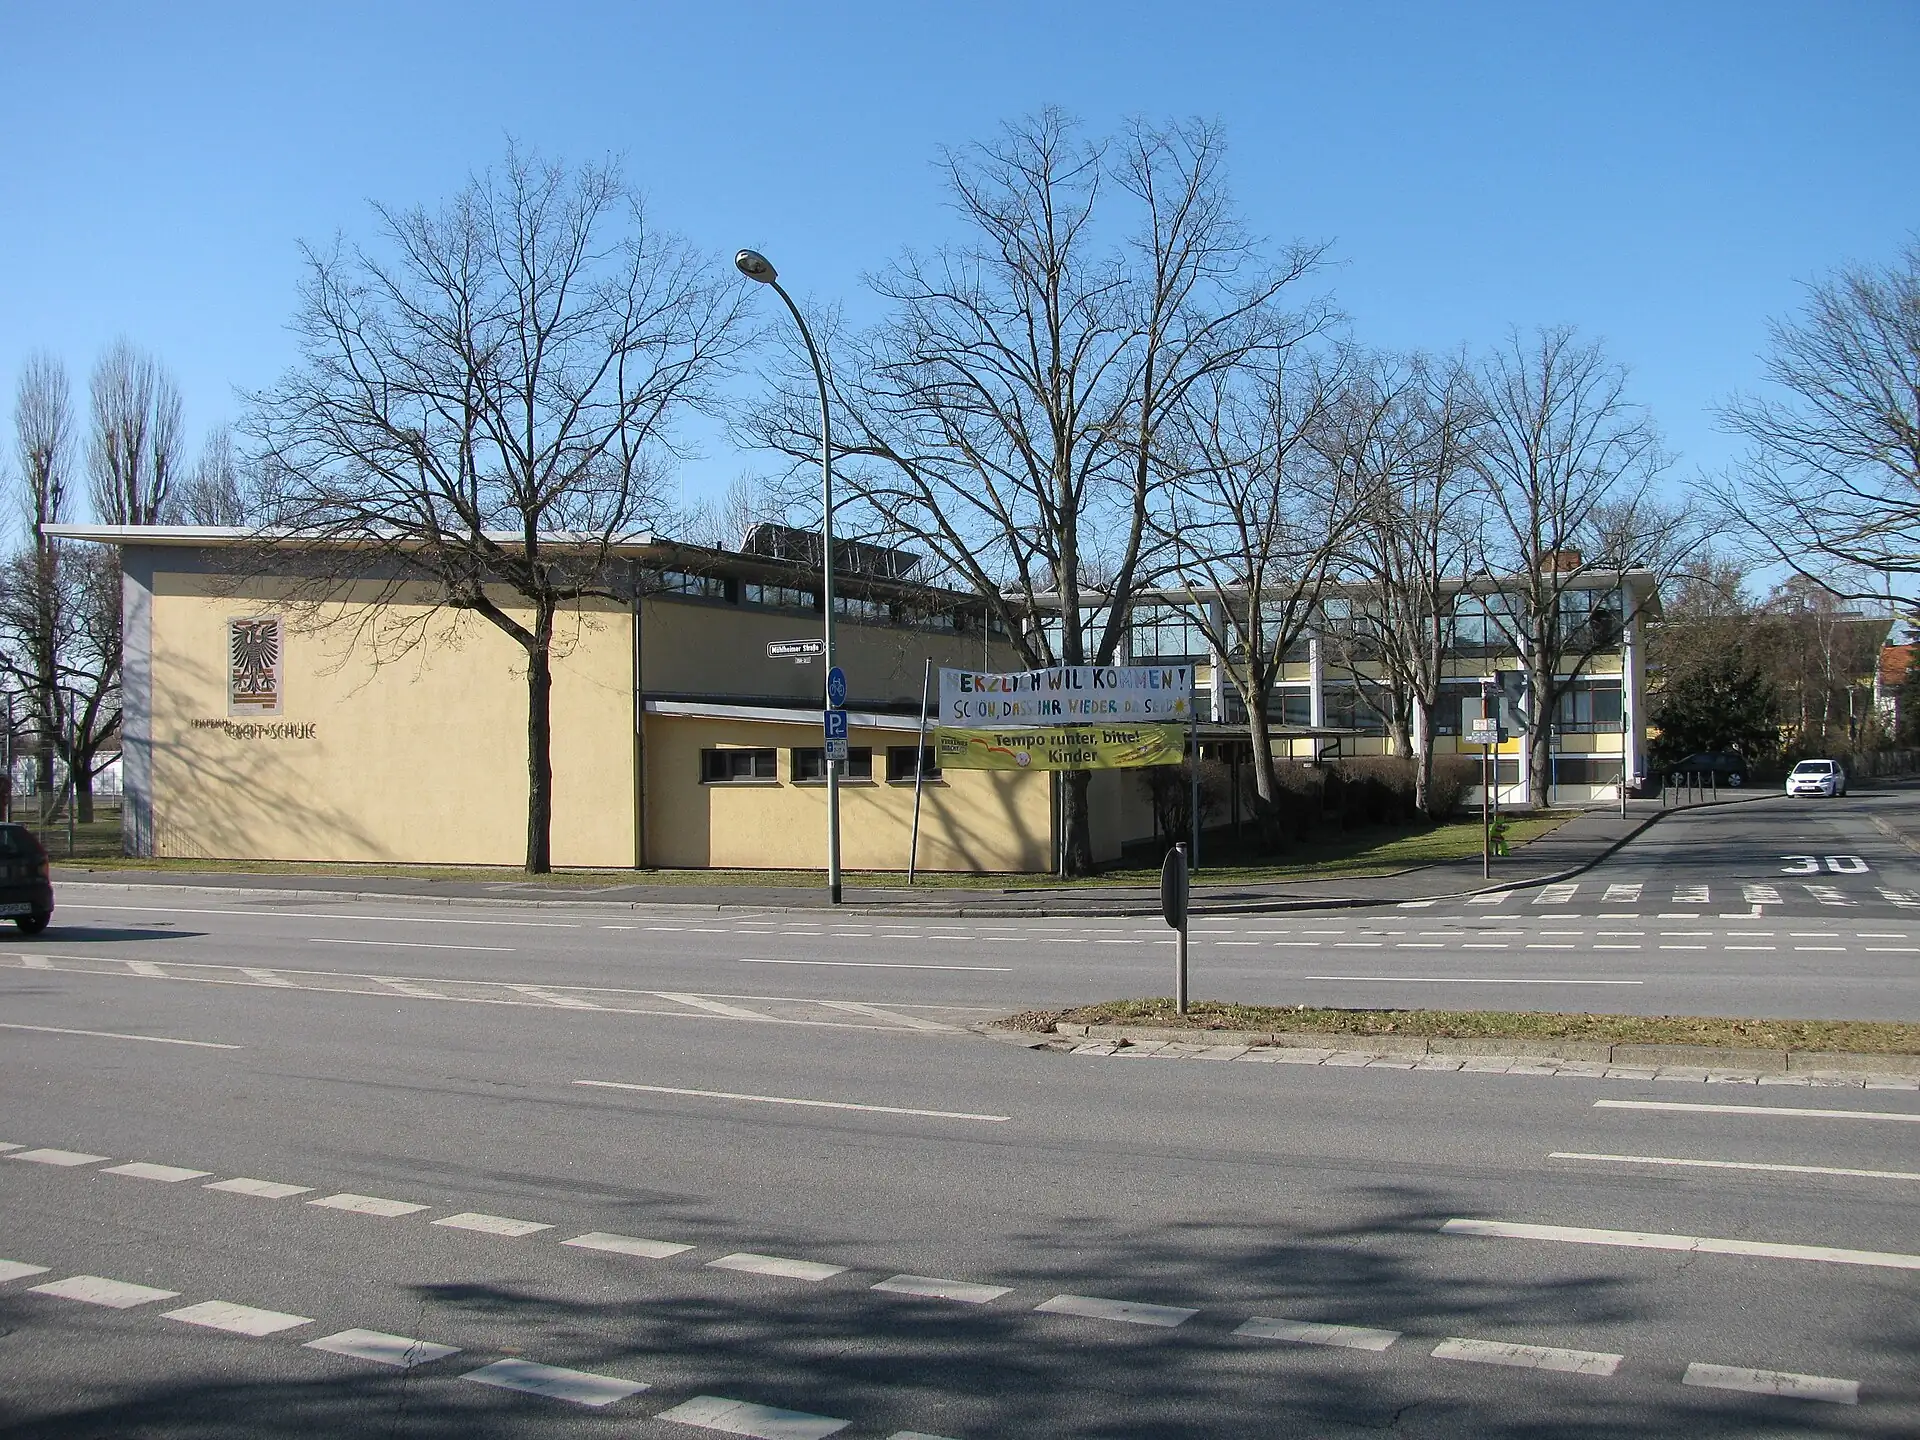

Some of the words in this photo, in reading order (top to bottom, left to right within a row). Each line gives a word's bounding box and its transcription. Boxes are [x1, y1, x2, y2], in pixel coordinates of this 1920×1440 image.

[1003, 700, 1032, 716] DASS
[1038, 700, 1061, 716] IHR
[1067, 699, 1117, 715] WIEDER
[830, 714, 841, 735] P
[994, 734, 1045, 749] Tempo
[1051, 731, 1098, 745] runter,
[1102, 730, 1140, 743] bitte!
[1048, 748, 1097, 763] Kinder
[1780, 855, 1869, 874] 30
